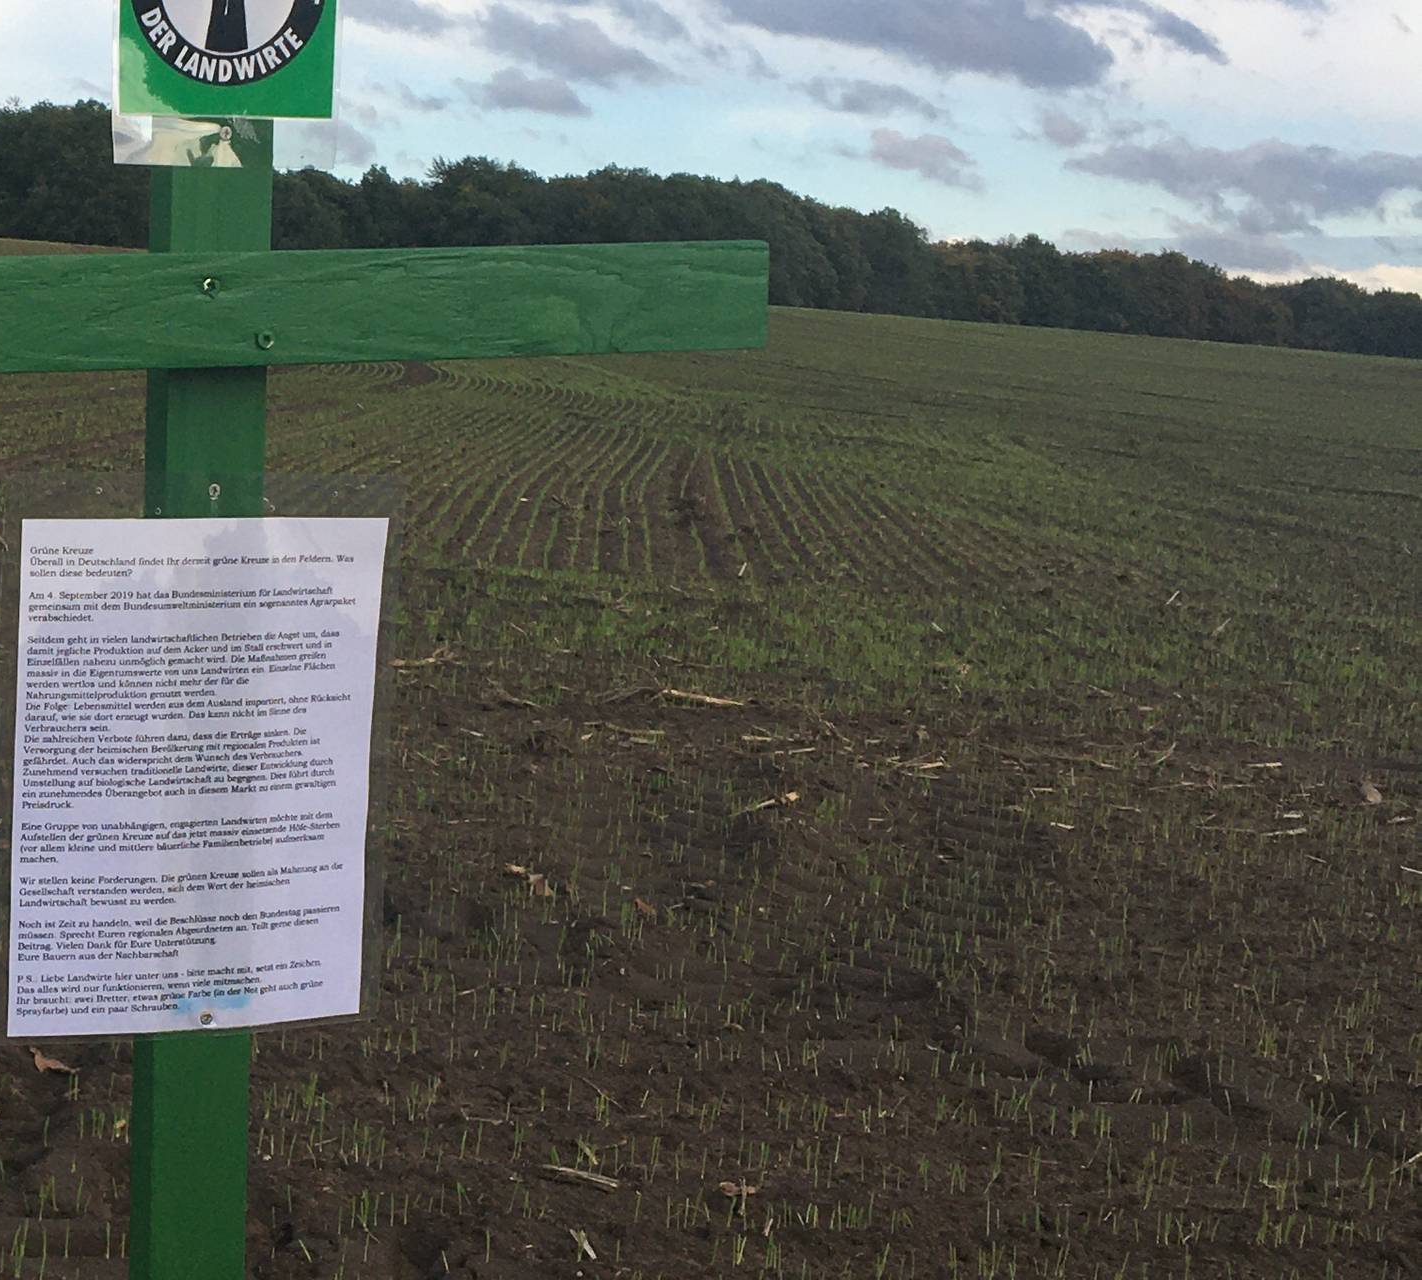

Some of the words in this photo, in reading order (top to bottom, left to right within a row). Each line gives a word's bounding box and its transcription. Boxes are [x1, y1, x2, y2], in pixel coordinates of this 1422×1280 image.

[141, 7, 177, 56] DER
[174, 27, 304, 82] LANDWIRTE
[29, 546, 59, 554] Grüne
[62, 546, 94, 554] Kreuze
[29, 557, 63, 566] Überall
[77, 558, 136, 566] Deutschland
[138, 557, 164, 565] findet
[240, 556, 270, 564] Kreuze
[298, 555, 334, 563] Feldern.
[29, 569, 56, 577] sollen
[59, 569, 83, 577] diese
[85, 569, 133, 577] bedeuten?
[58, 591, 108, 601] September
[109, 591, 134, 599] 2019
[171, 589, 256, 598] Bundesministerium
[272, 587, 333, 596] Landwirtschaft
[28, 602, 81, 613] gemeinsam
[100, 602, 121, 610] dem
[123, 600, 241, 610] Bundesumweltministerium
[258, 598, 308, 609] sogenanntes
[309, 597, 356, 608] Agrarpaket
[28, 614, 94, 622] verabschiedet.
[27, 635, 65, 643] Seitdem
[66, 635, 87, 645] geht
[102, 635, 128, 643] vielen
[130, 633, 219, 643] landwirtschaftlichen
[220, 632, 262, 641] Betrieben
[277, 630, 300, 642] Angst
[26, 647, 54, 655] damit
[56, 647, 91, 657] jegliche
[93, 646, 144, 654] Produktion
[183, 644, 209, 653] Acker
[244, 643, 264, 652] Stall
[265, 642, 303, 651] erschwert
[26, 658, 80, 666] Einzelfällen
[82, 658, 116, 666] nahezu
[118, 657, 166, 668] unmöglich
[167, 655, 204, 667] gemacht
[247, 652, 297, 663] Maßnahmen
[298, 652, 326, 662] greifen
[26, 669, 58, 677] massiv
[89, 668, 162, 679] Eigentumswerte
[200, 665, 249, 675] Landwirten
[268, 664, 301, 673] Einzelne
[303, 662, 335, 672] Flächen
[26, 680, 60, 688] werden
[62, 680, 95, 688] wertlos
[118, 679, 152, 687] können
[155, 678, 177, 687] nicht
[179, 678, 202, 686] mehr
[25, 690, 147, 701] Nahrungsmittelproduktion
[149, 689, 182, 700] genutzt
[73, 702, 132, 710] Lebensmittel
[134, 701, 166, 709] werden
[207, 698, 243, 707] Ausland
[288, 695, 308, 704] ohne
[310, 693, 350, 703] Rücksicht
[115, 712, 148, 723] erzeugt
[207, 710, 230, 718] kann
[232, 709, 254, 718] nicht
[24, 724, 87, 732] Verbrauchers
[89, 723, 112, 732] sein.
[41, 735, 95, 743] zahlreichen
[98, 734, 132, 743] Verbote
[135, 734, 165, 742] führen
[192, 732, 213, 740] dass
[230, 730, 262, 741] Erträge
[23, 746, 77, 756] Versorgung
[96, 745, 148, 753] heimischen
[151, 743, 204, 755] Bevölkerung
[222, 741, 267, 752] regionalen
[268, 738, 308, 749] Produkten
[22, 767, 78, 776] Zunehmend
[80, 767, 128, 775] versuchen
[130, 766, 182, 775] traditionelle
[232, 763, 258, 772] dieser
[309, 757, 333, 768] durch
[72, 756, 96, 765] Auch
[117, 755, 172, 766] widerspricht
[195, 753, 230, 762] Wunsch
[22, 778, 76, 789] Umstellung
[95, 778, 146, 788] biologische
[148, 776, 211, 786] Landwirtschaft
[288, 770, 308, 780] führt
[310, 768, 334, 778] durch
[38, 789, 103, 798] zunehmendes
[104, 787, 162, 799] Überangebot
[164, 787, 185, 796] auch
[198, 785, 228, 794] diesem
[230, 784, 256, 793] Markt
[269, 782, 292, 792] einem
[294, 779, 336, 792] gewaltigen
[22, 801, 72, 809] Preisdruck.
[21, 822, 42, 831] Eine
[44, 822, 80, 832] Gruppe
[220, 816, 267, 826] Landwirten
[269, 814, 298, 824] möchte
[20, 833, 66, 841] Aufstellen
[86, 833, 119, 843] grünen
[122, 832, 153, 840] Kreuze
[209, 828, 239, 837] massiv
[40, 844, 65, 852] allem
[67, 844, 95, 852] kleine
[118, 842, 154, 851] mittlere
[19, 855, 60, 863] machen.
[38, 876, 68, 884] stellen
[70, 876, 96, 884] keine
[177, 872, 207, 884] grünen
[209, 870, 239, 880] Kreuze
[241, 868, 265, 878] sollen
[18, 887, 74, 896] Gesellschaft
[77, 887, 127, 895] verstanden
[245, 876, 290, 888] heimischen
[19, 898, 87, 907] Landwirtschaft
[90, 898, 127, 906] bewusst
[18, 920, 42, 929] Noch
[169, 914, 216, 925] Beschlüsse
[218, 913, 240, 922] noch
[259, 908, 301, 922] Bundestag
[302, 904, 340, 918] passieren
[59, 930, 95, 941] Sprecht
[97, 930, 126, 938] Euren
[127, 928, 174, 940] regionalen
[175, 924, 233, 938] Abgeordneten
[269, 921, 292, 931] gerne
[293, 916, 318, 927] diesen
[56, 941, 84, 950] Vielen
[86, 941, 112, 949] Dank
[130, 940, 152, 948] Eure
[17, 953, 40, 961] Eure
[42, 952, 76, 961] Bauern
[115, 949, 179, 959] Nachbarschaft
[40, 974, 65, 982] Liebe
[67, 973, 112, 982] Landwirte
[134, 971, 161, 980] unter
[207, 966, 234, 976] macht
[37, 985, 58, 994] alles
[132, 993, 158, 1002] etwas
[16, 1006, 69, 1018] Sprayfarbe)
[107, 1006, 128, 1015] paar
